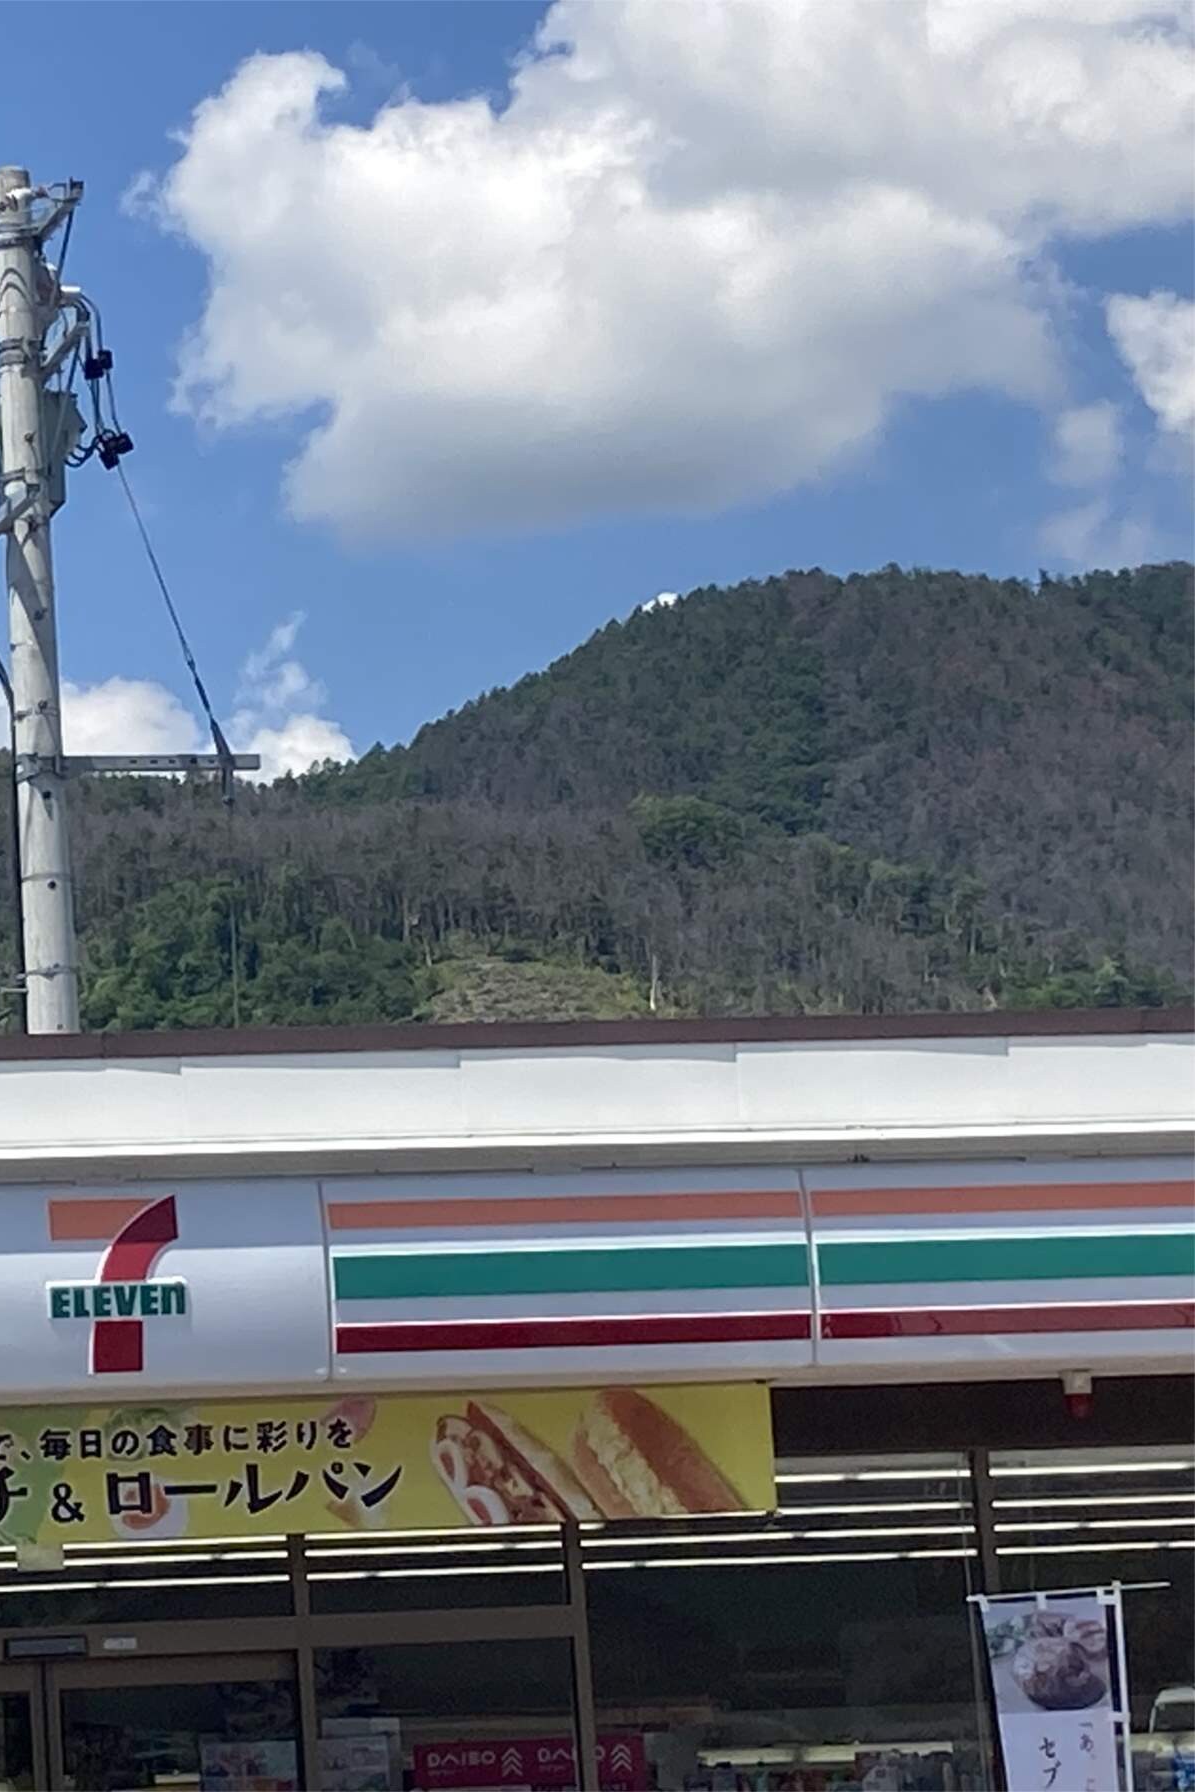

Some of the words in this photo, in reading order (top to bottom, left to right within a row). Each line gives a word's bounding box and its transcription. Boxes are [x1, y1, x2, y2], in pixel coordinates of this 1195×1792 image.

[49, 1195, 179, 1372] 7
[51, 1483, 85, 1523] &
[106, 1461, 403, 1515] ロールパン
